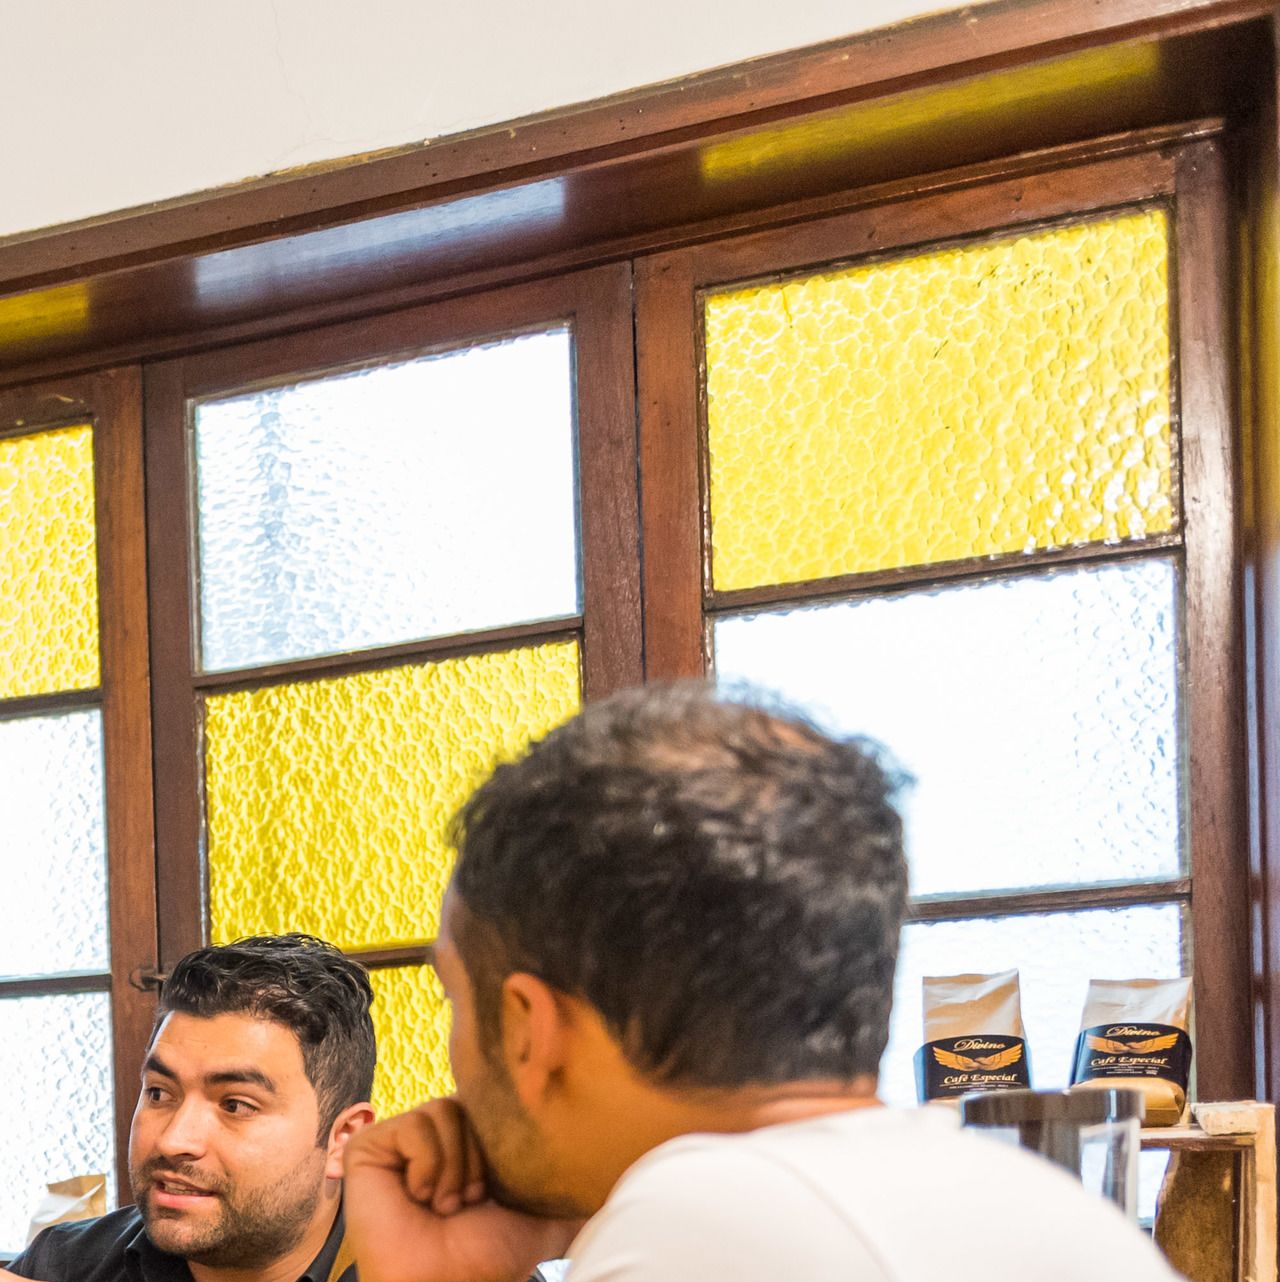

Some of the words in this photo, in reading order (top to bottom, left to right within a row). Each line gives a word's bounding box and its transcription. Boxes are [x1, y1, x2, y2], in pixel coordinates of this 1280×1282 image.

[1104, 1025, 1161, 1038] Divino
[952, 1038, 1006, 1052] Divino
[1091, 1056, 1117, 1067] Café
[1117, 1056, 1169, 1066] Especial
[943, 1073, 969, 1085] Café
[970, 1073, 1018, 1084] Especial
